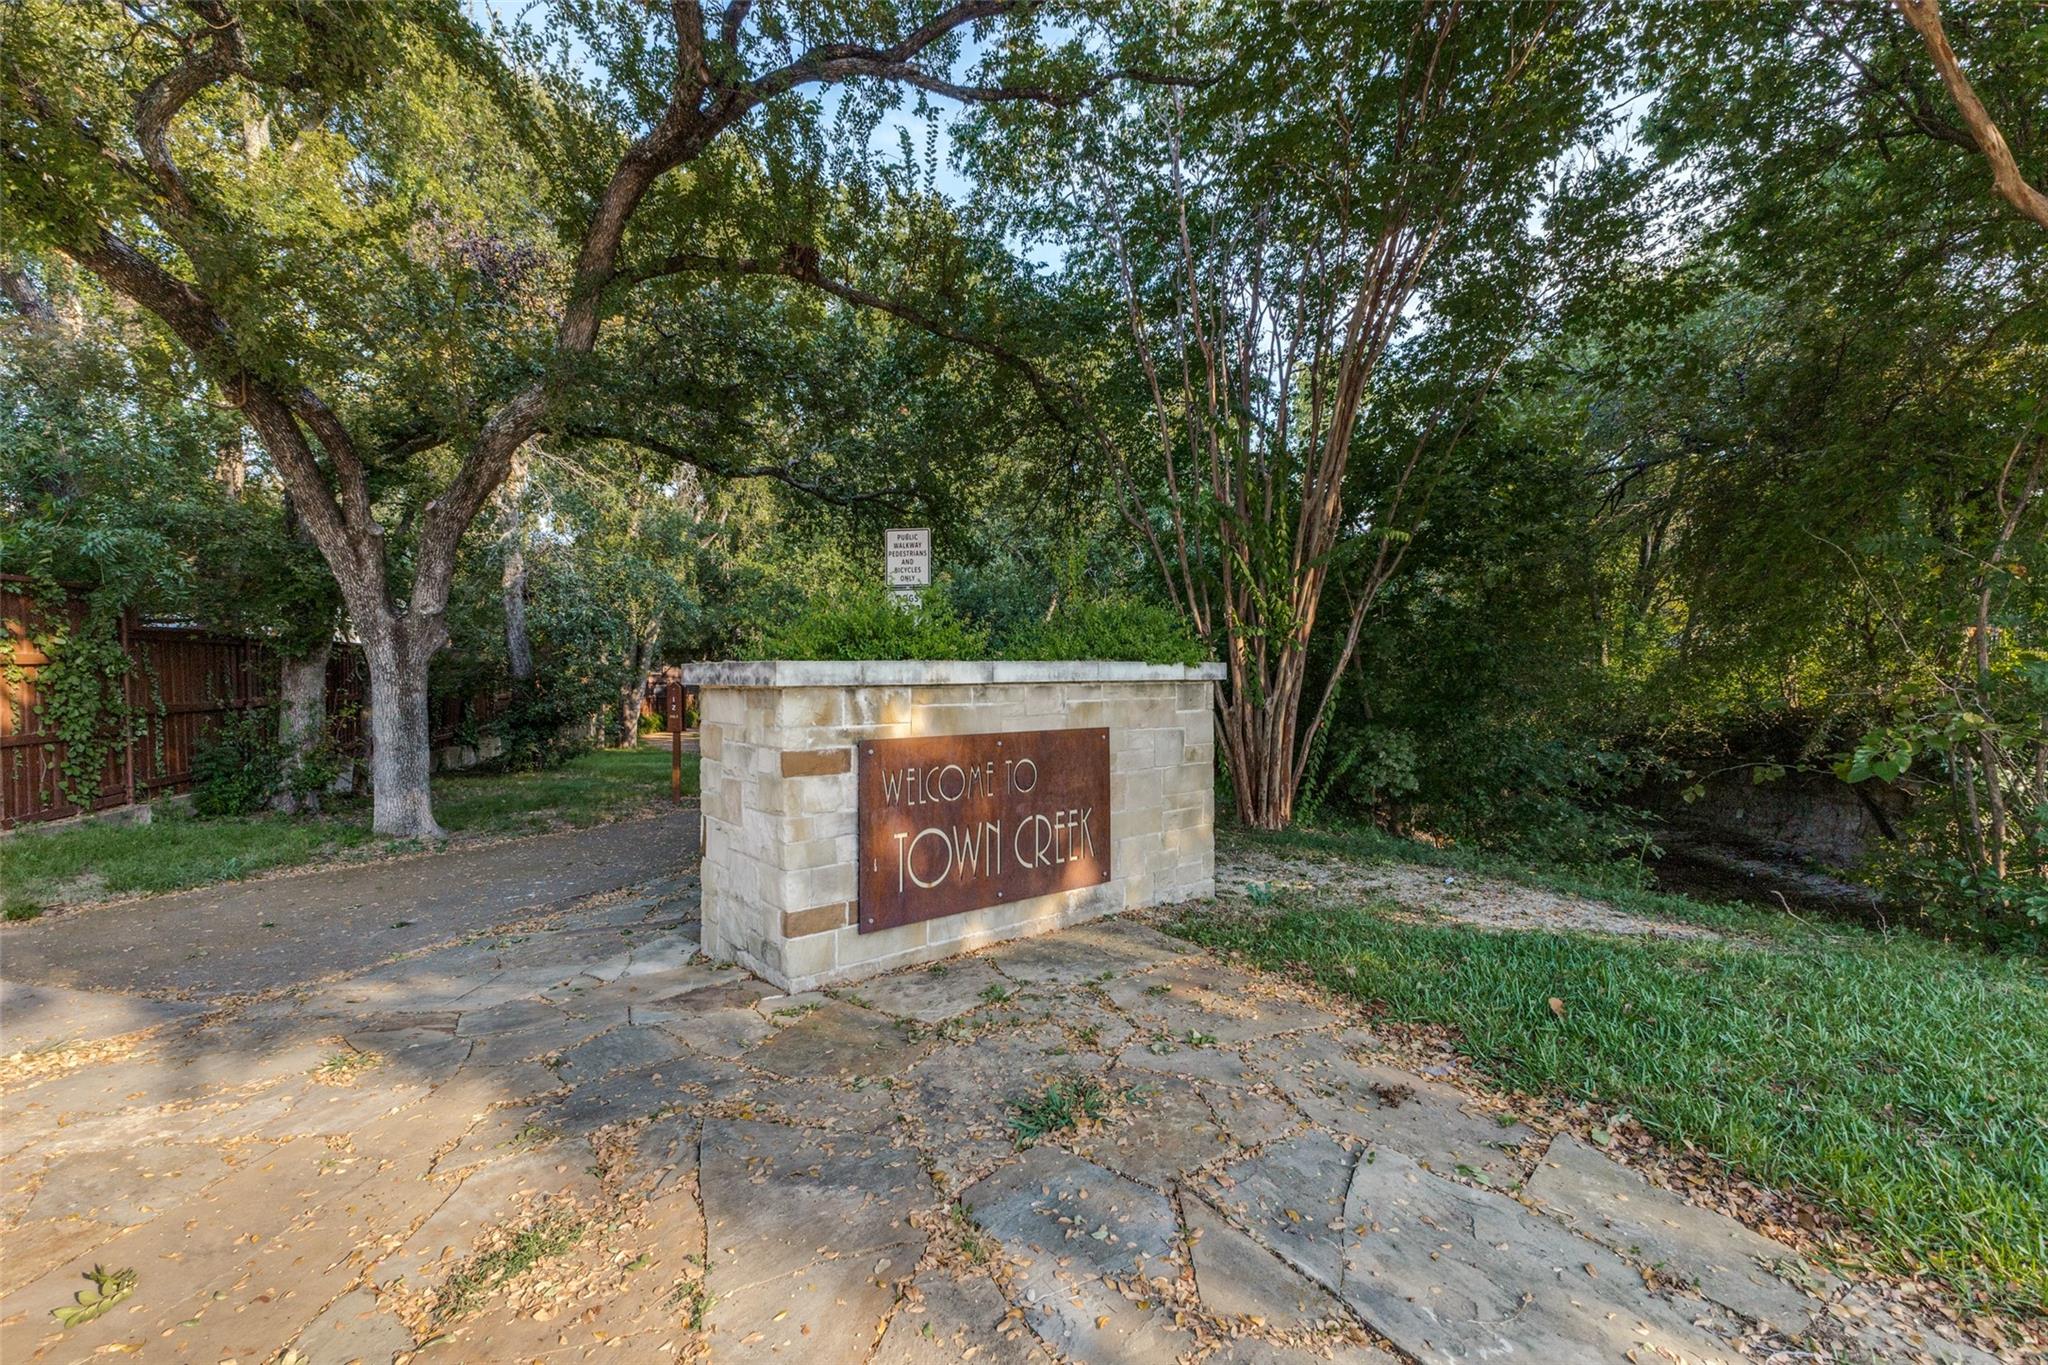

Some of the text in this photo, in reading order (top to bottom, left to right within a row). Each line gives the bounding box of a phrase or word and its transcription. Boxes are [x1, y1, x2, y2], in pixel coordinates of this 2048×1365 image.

[897, 533, 918, 541] PUBLIC
[881, 758, 1038, 806] WELCOME TO
[894, 807, 1096, 893] TOWN CREEK
